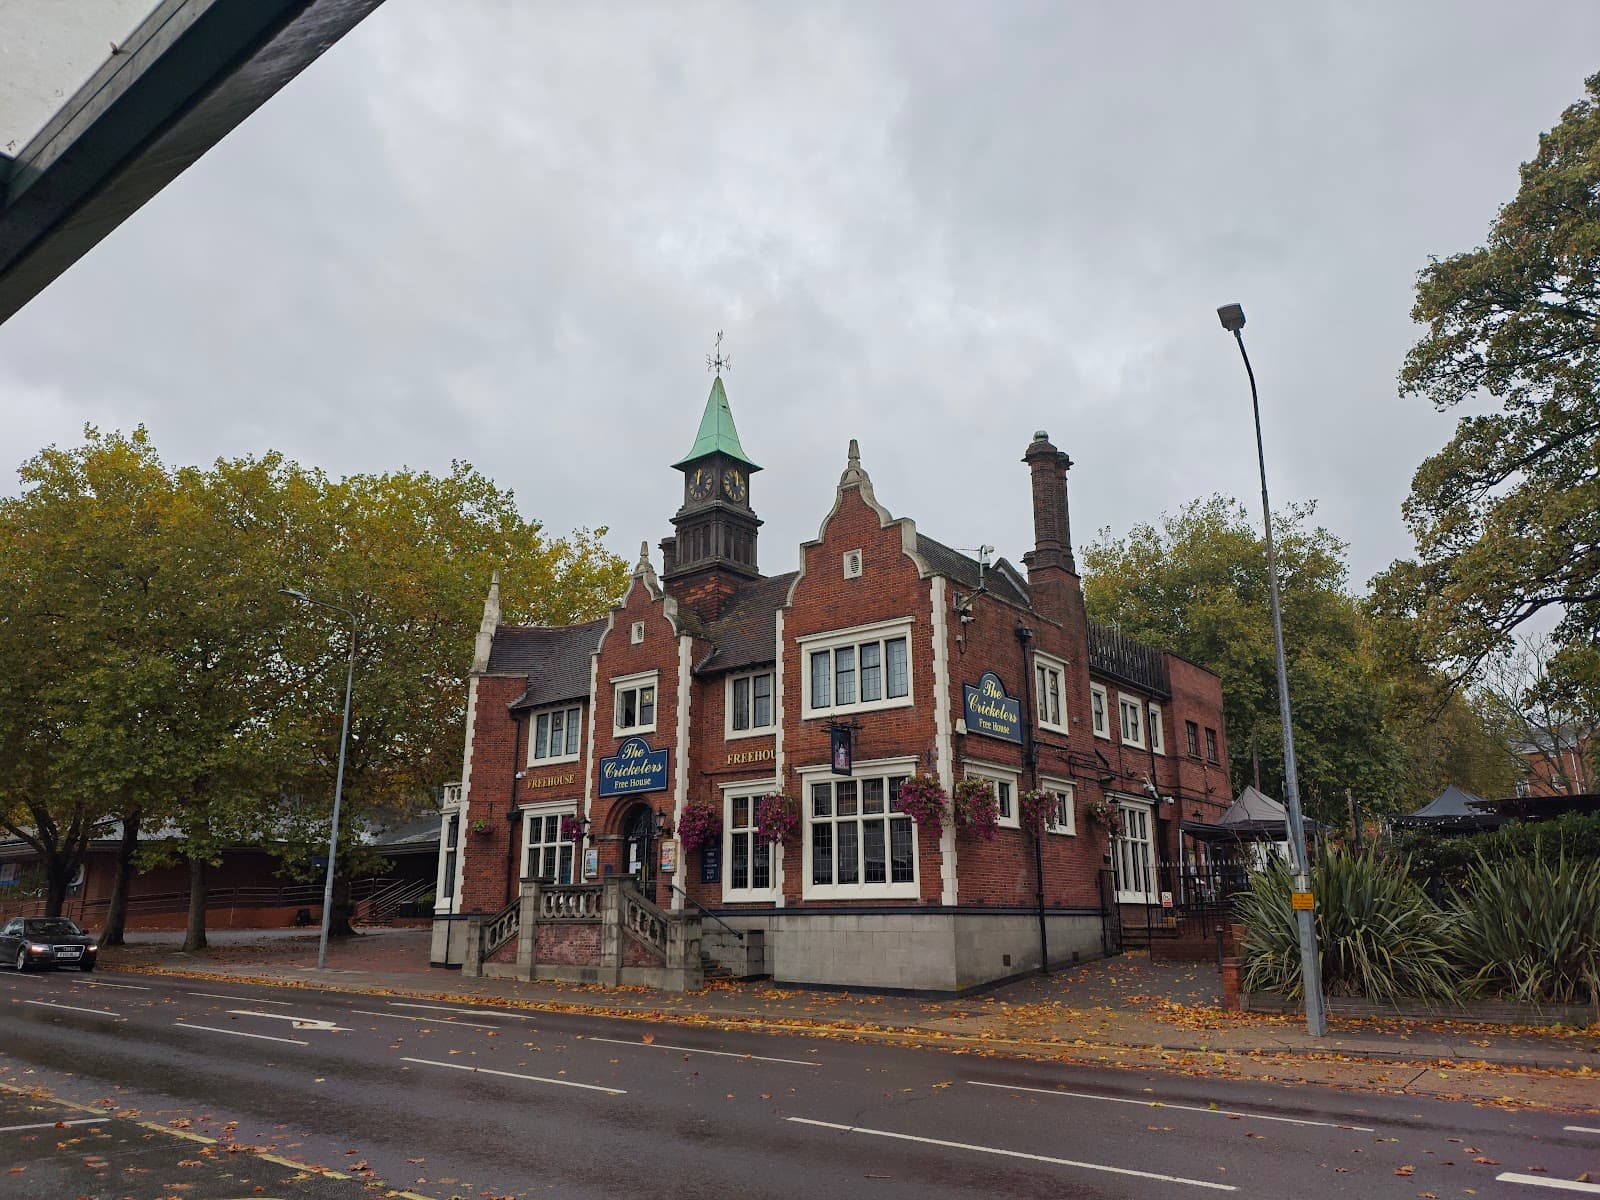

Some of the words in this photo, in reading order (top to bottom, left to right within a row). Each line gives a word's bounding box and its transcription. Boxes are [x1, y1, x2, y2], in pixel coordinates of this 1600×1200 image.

[983, 680, 1002, 699] The
[968, 693, 1017, 723] Cricketers
[979, 719, 991, 729] Free
[992, 721, 1010, 734] House
[622, 743, 645, 759] The
[604, 759, 663, 778] Cricketers
[528, 774, 575, 789] FREEHOUSE
[614, 780, 629, 789] Free
[630, 778, 651, 787] House
